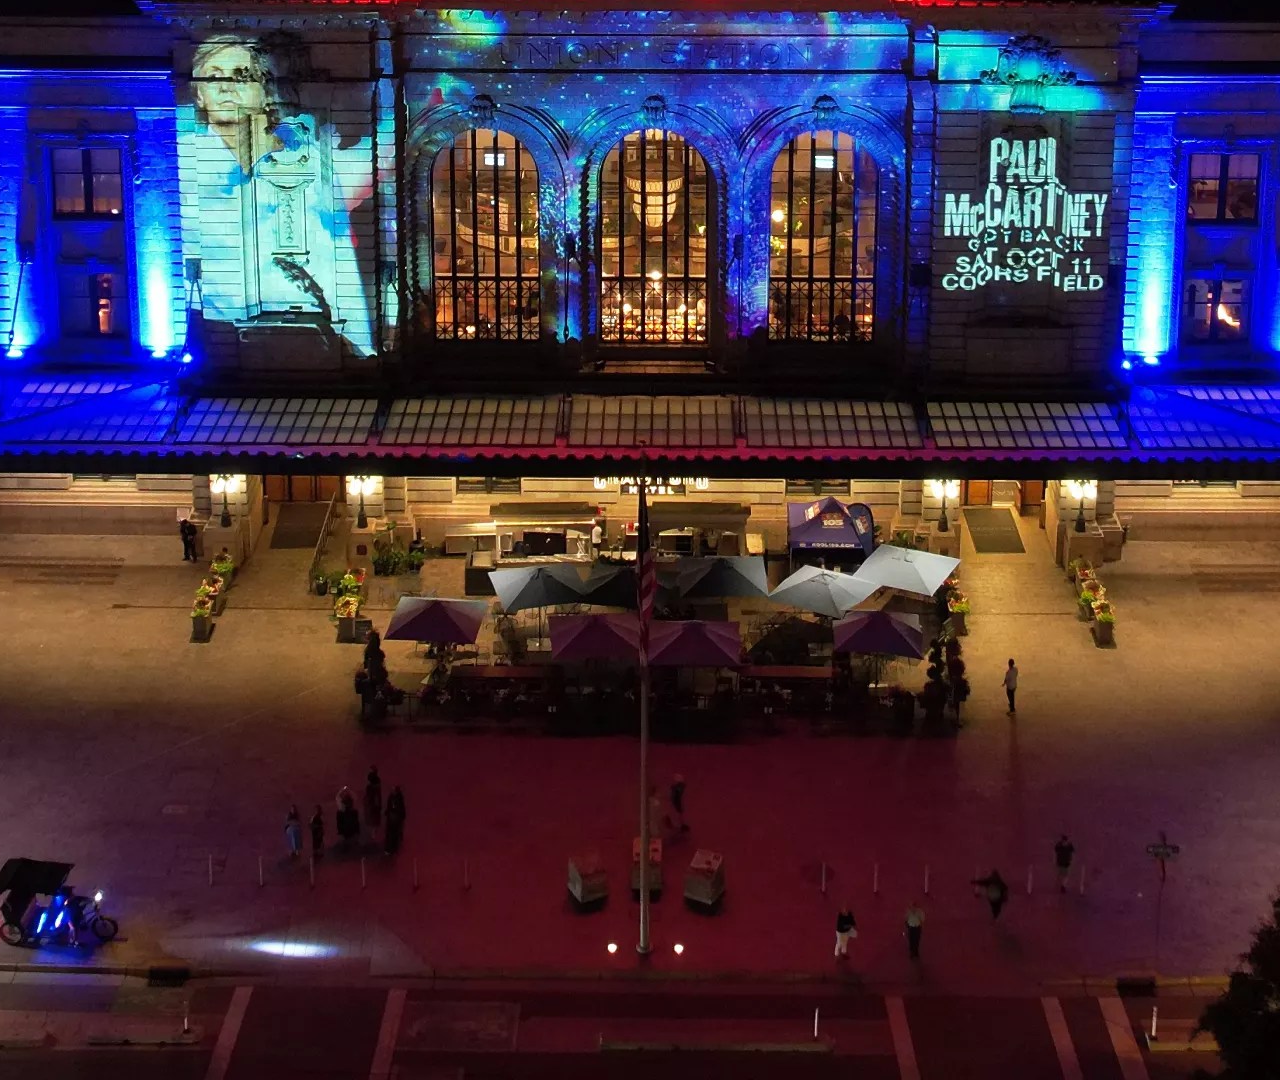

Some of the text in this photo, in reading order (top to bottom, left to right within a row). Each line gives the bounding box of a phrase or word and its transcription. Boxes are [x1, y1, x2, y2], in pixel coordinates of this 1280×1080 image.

[990, 136, 1062, 184] PAUL
[943, 182, 1108, 237] McCARTNEY
[968, 228, 1084, 253] GOT BACK
[956, 247, 1091, 274] SAT OCT 11
[942, 265, 1104, 292] COORS FIELD
[628, 486, 675, 495] HTEL
